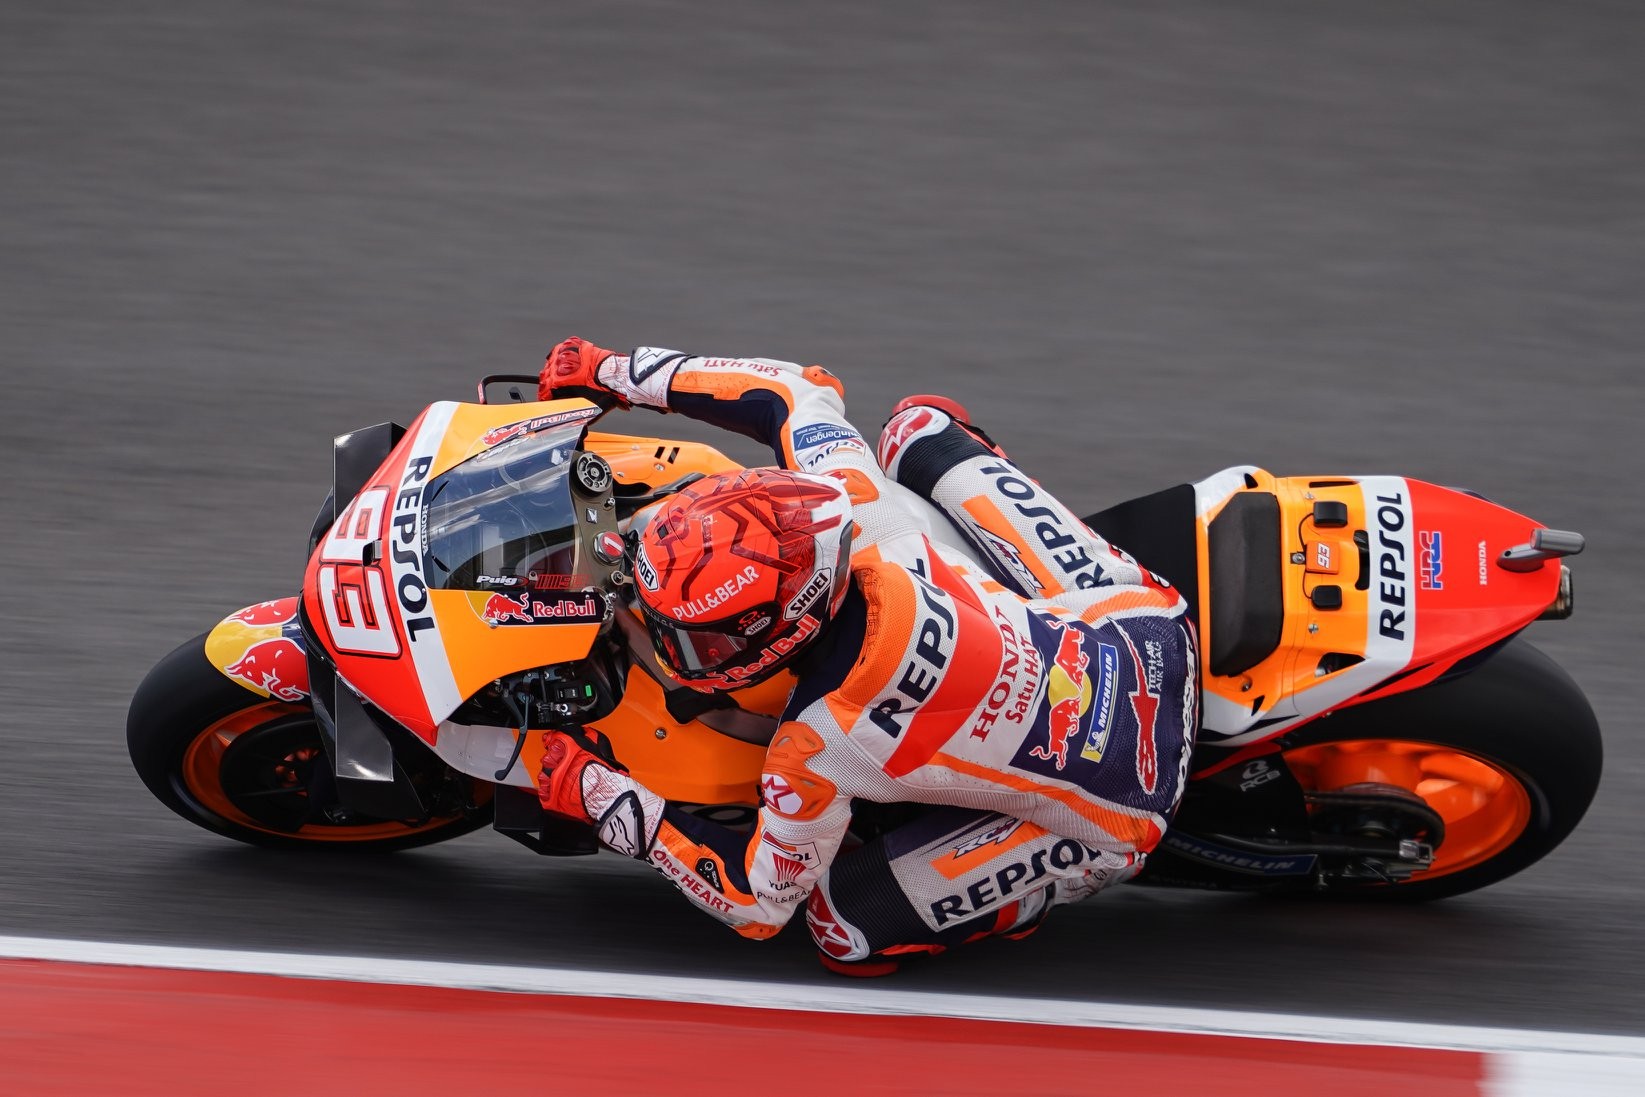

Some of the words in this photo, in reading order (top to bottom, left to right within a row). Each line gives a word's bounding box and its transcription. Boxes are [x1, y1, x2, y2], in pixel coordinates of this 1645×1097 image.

[746, 361, 783, 378] Satu
[389, 455, 436, 643] REPSOL
[420, 503, 429, 557] HONDA
[979, 461, 1114, 590] REPSOL
[317, 489, 401, 656] 93
[1317, 542, 1330, 569] 93
[1377, 492, 1405, 641] REPSOL
[1419, 531, 1444, 591] HRC
[1479, 540, 1487, 585] HONDA
[476, 575, 518, 586] Puig
[672, 565, 760, 621] PULL&BEAR
[793, 571, 828, 616] SHOEI
[533, 600, 565, 617] Red
[565, 598, 596, 616] Bull
[748, 619, 769, 634] SHOEI
[725, 648, 780, 681] Red
[770, 613, 820, 656] Bull
[1005, 680, 1037, 724] Satu
[1098, 653, 1113, 728] MICHELIN
[1155, 669, 1164, 692] AIR
[1167, 836, 1296, 871] MICHELIN
[653, 849, 681, 876] One
[681, 873, 734, 914] HEART
